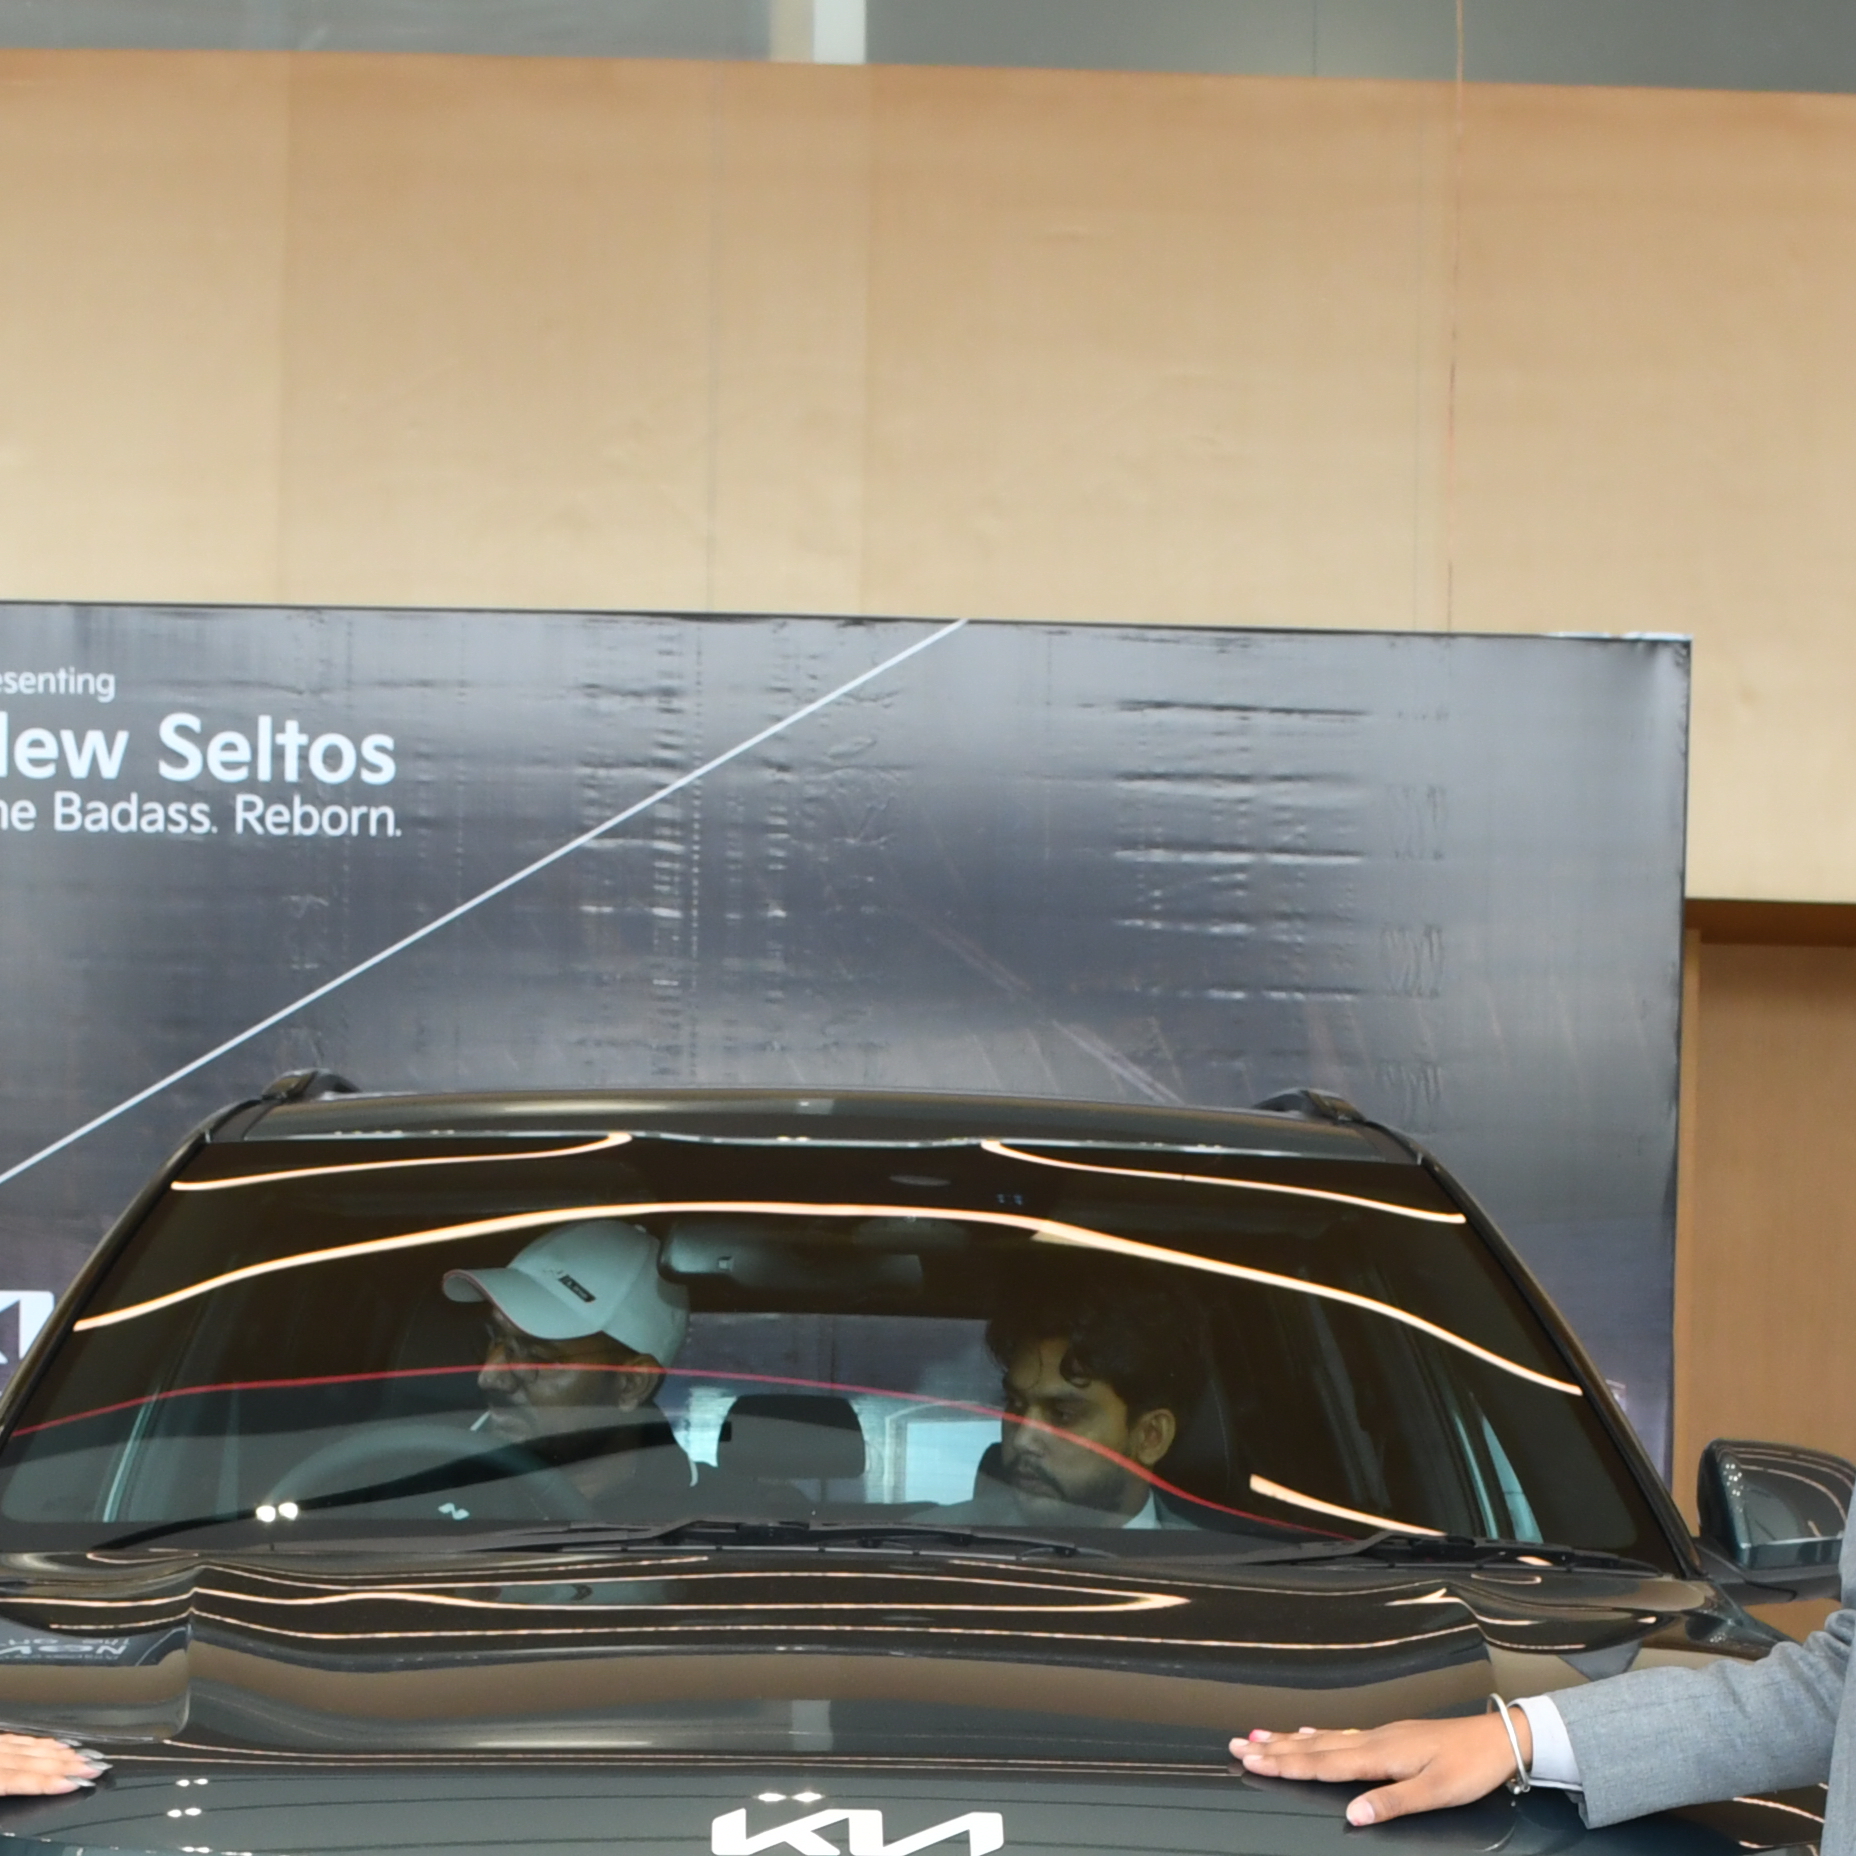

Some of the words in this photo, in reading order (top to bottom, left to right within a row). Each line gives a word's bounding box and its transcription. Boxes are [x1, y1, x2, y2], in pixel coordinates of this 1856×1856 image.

[158, 712, 396, 784] Seltos
[53, 791, 218, 833] Badass.
[235, 794, 402, 837] Reborn.
